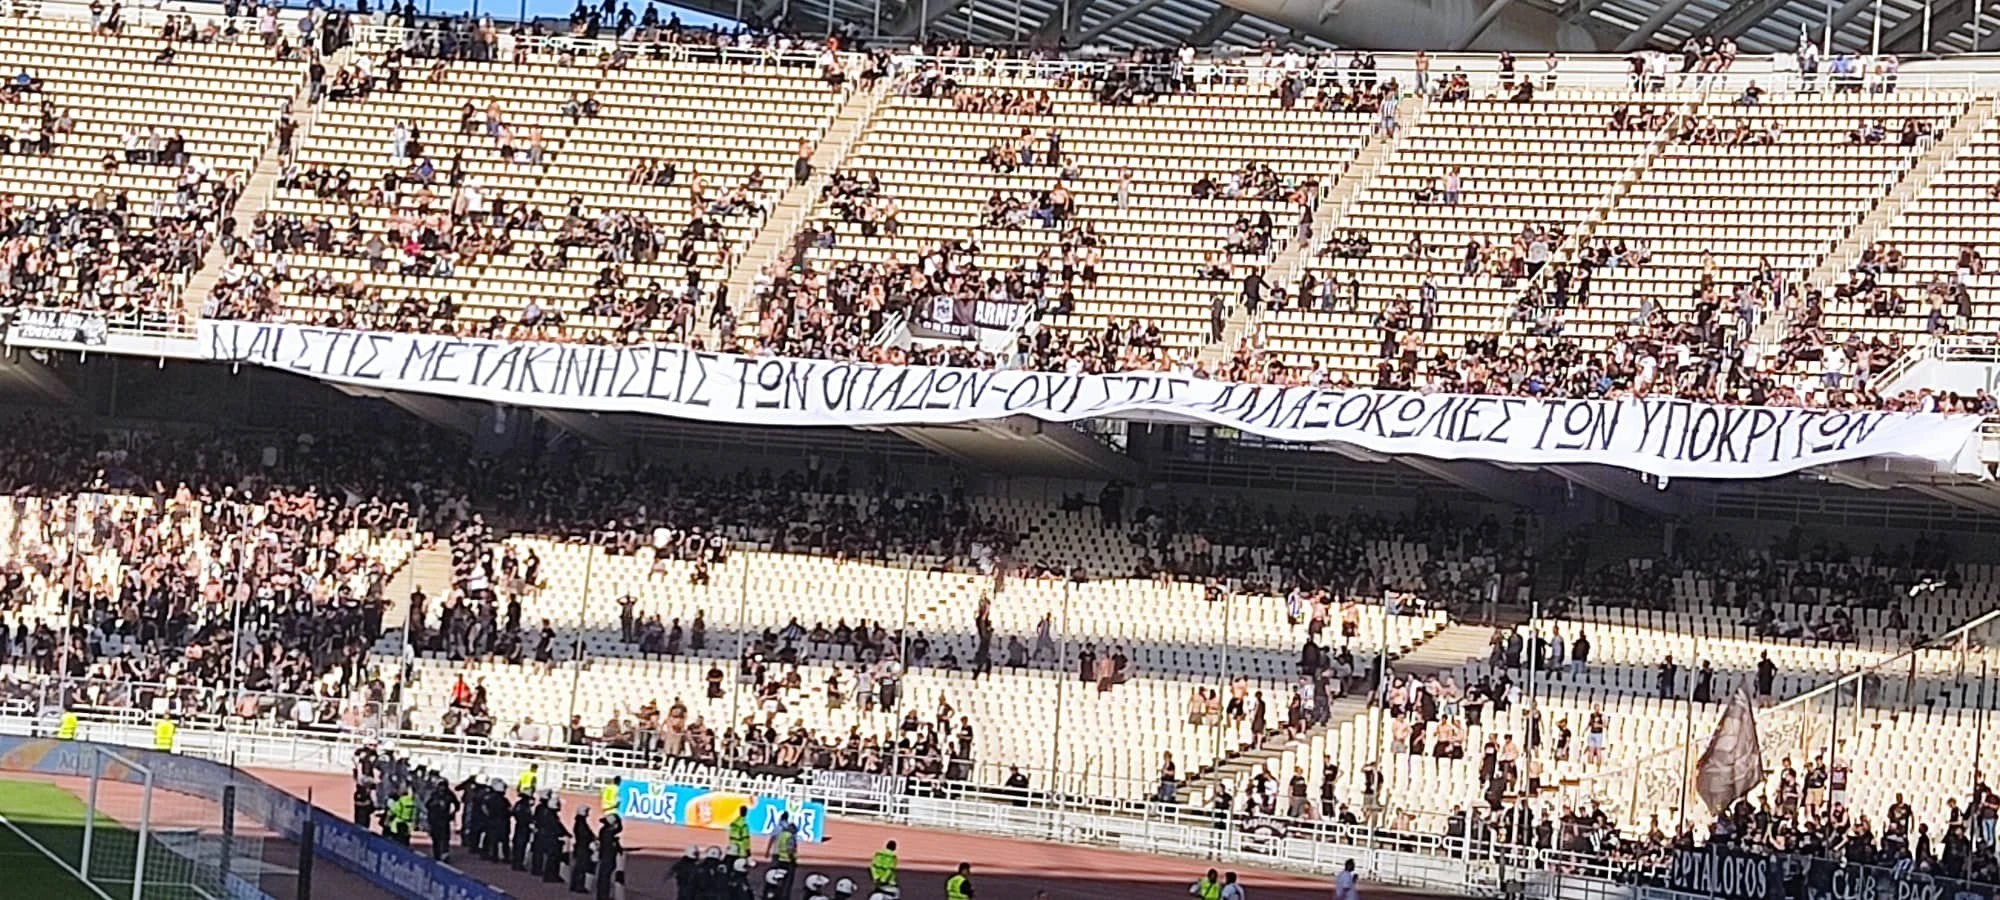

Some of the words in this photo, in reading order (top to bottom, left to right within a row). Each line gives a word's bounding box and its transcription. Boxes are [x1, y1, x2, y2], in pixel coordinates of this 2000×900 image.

[211, 324, 284, 362] ΝΑΙ
[290, 329, 393, 380] ΣΤΙΣ
[397, 338, 717, 406] ΜΕΤΑΚΙΝΗΣΕΙΣ
[734, 357, 814, 410] ΤΩΝ
[1532, 399, 1621, 450] ΤΩΝ
[1634, 400, 1888, 463] ΥΠΟΚΡΙΤΩΝ
[764, 804, 815, 842] λξ
